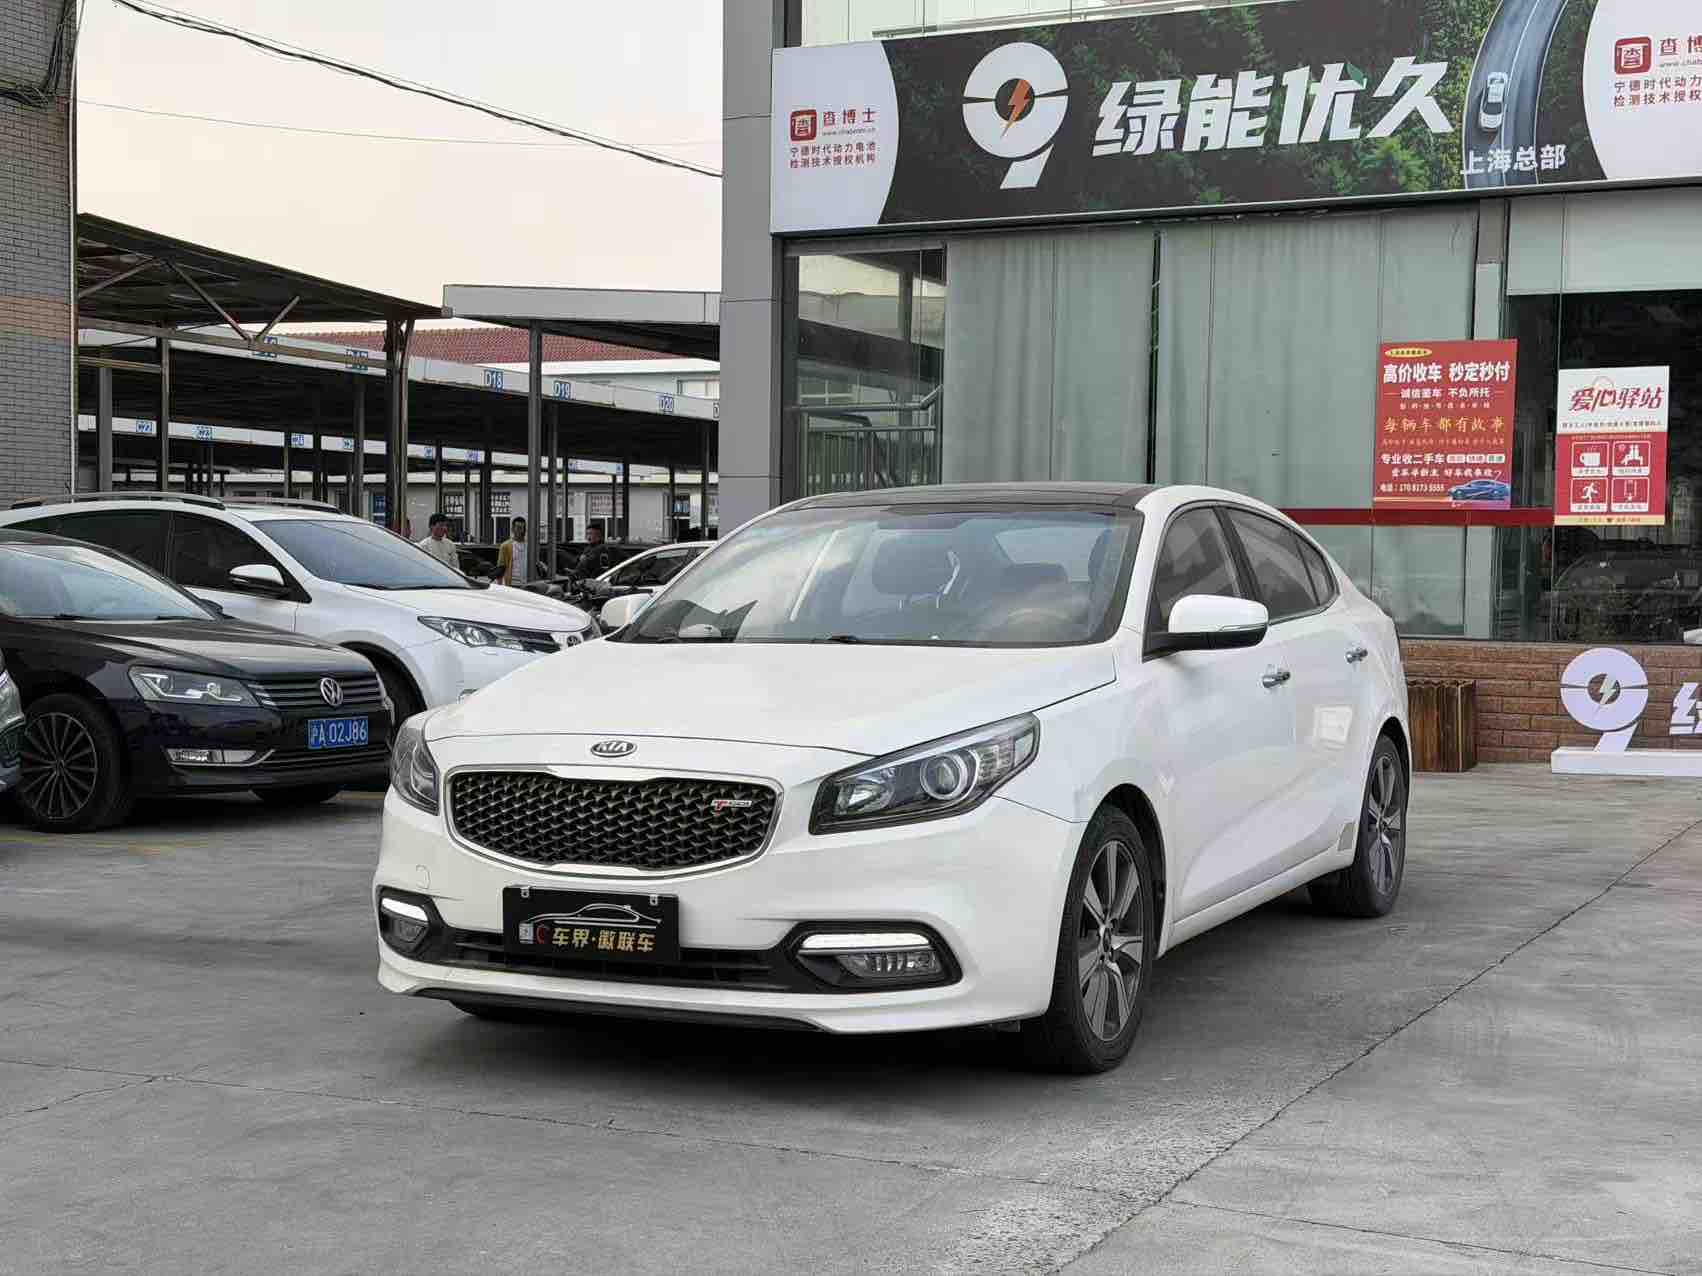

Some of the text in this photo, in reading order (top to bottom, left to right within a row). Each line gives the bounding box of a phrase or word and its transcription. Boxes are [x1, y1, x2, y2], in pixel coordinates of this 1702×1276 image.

[1092, 56, 1455, 157] 绿能优久
[1459, 144, 1567, 176] 上海总部
[1383, 360, 1511, 384] 高价收车 秒定秒付
[553, 381, 571, 399] D19
[1447, 387, 1491, 399] 不负所托
[1568, 386, 1665, 413] 爱心驿站
[1381, 453, 1446, 466] 专业收二手车
